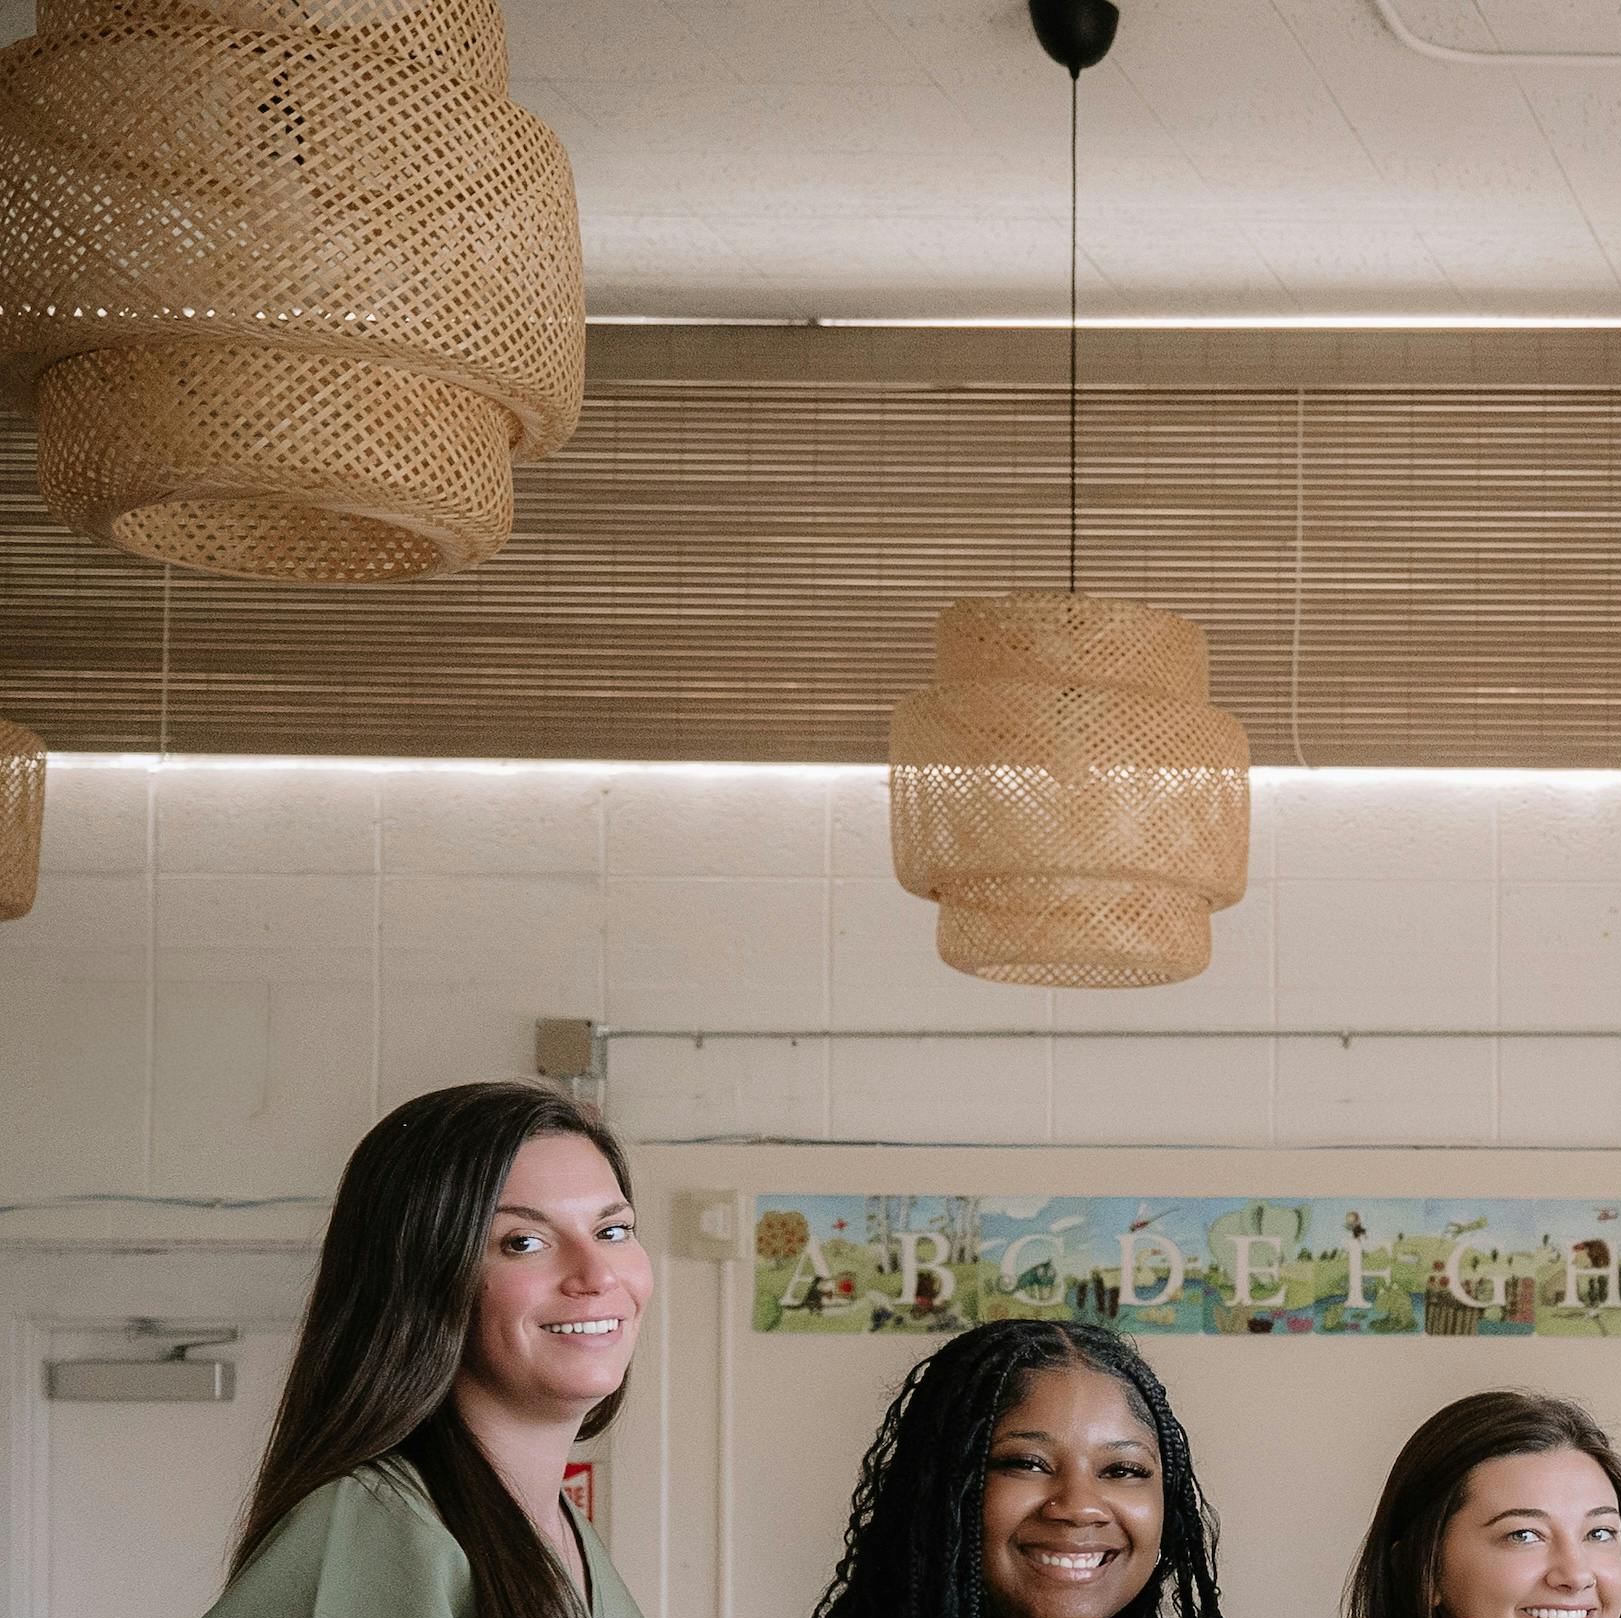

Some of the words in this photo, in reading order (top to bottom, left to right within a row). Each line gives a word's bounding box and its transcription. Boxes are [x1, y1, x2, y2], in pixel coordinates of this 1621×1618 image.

[779, 1234, 859, 1315] A
[890, 1231, 958, 1306] B
[999, 1234, 1072, 1307] C
[1114, 1234, 1185, 1307] D
[1224, 1234, 1287, 1308] E
[1343, 1237, 1393, 1310] F
[1445, 1236, 1508, 1309] G
